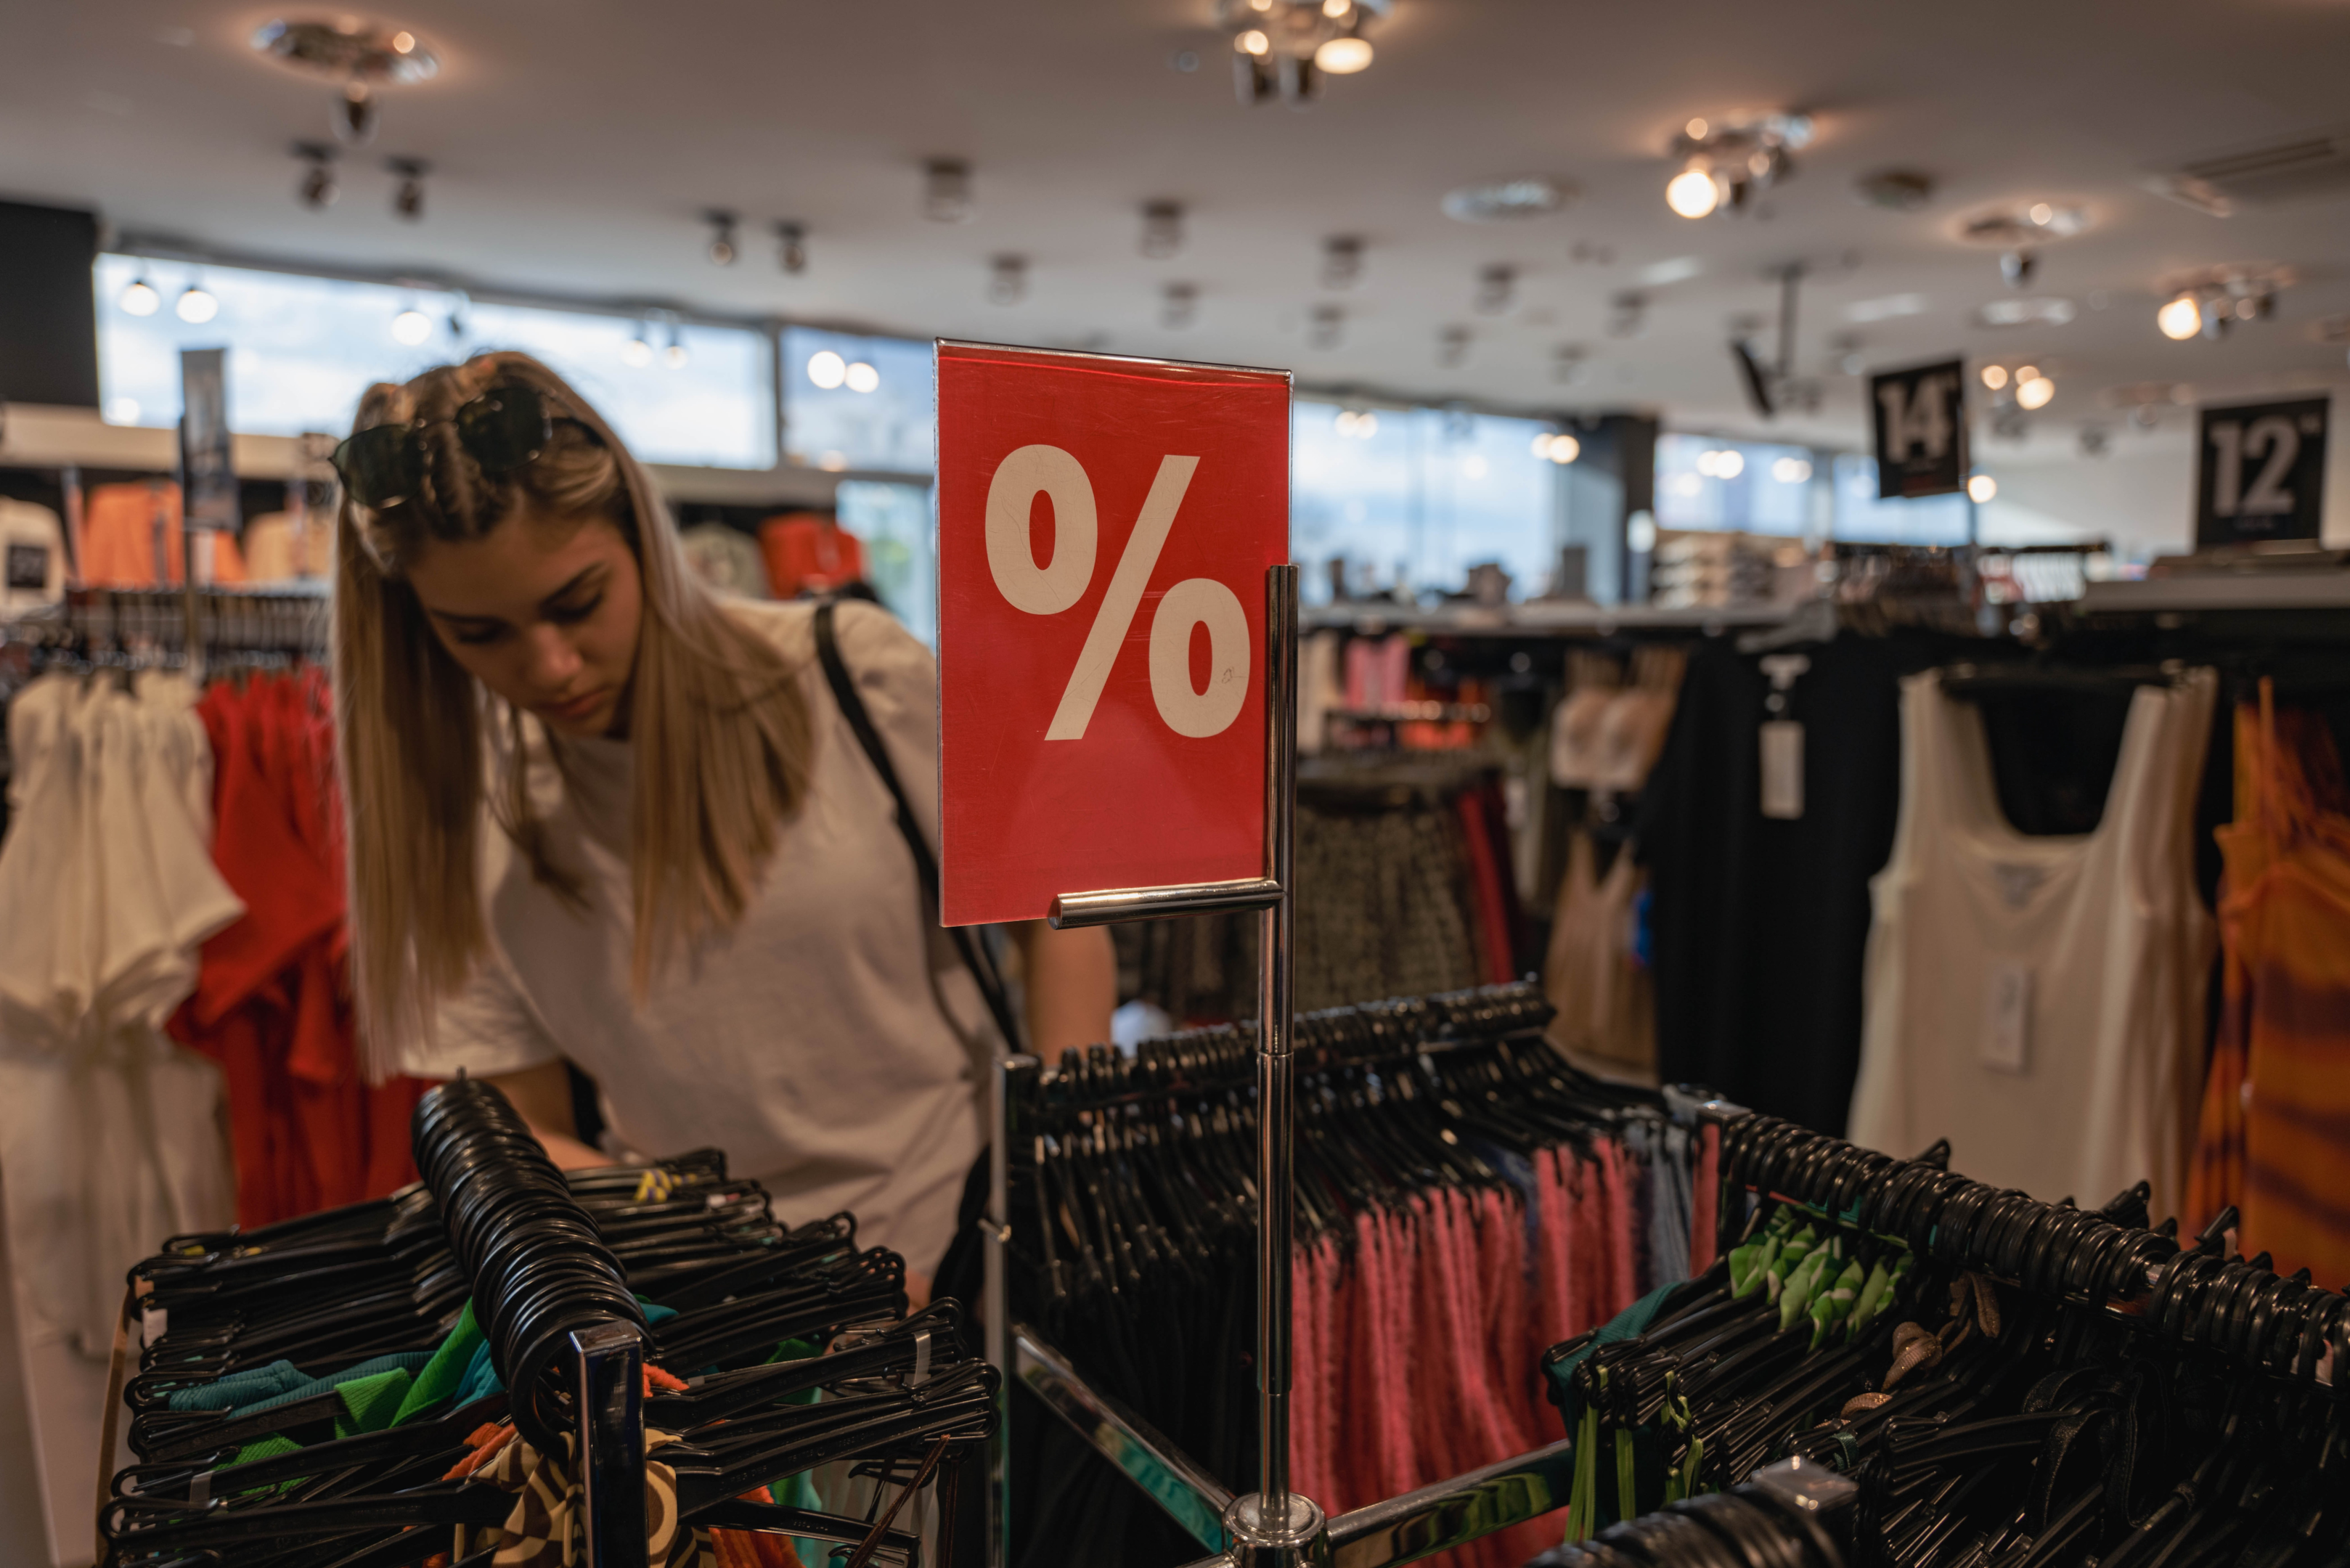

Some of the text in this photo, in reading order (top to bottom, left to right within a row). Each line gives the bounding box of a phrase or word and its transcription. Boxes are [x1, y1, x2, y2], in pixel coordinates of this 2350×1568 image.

[1878, 375, 1950, 463] 14
[2210, 415, 2299, 518] 12
[985, 444, 1251, 740] %
